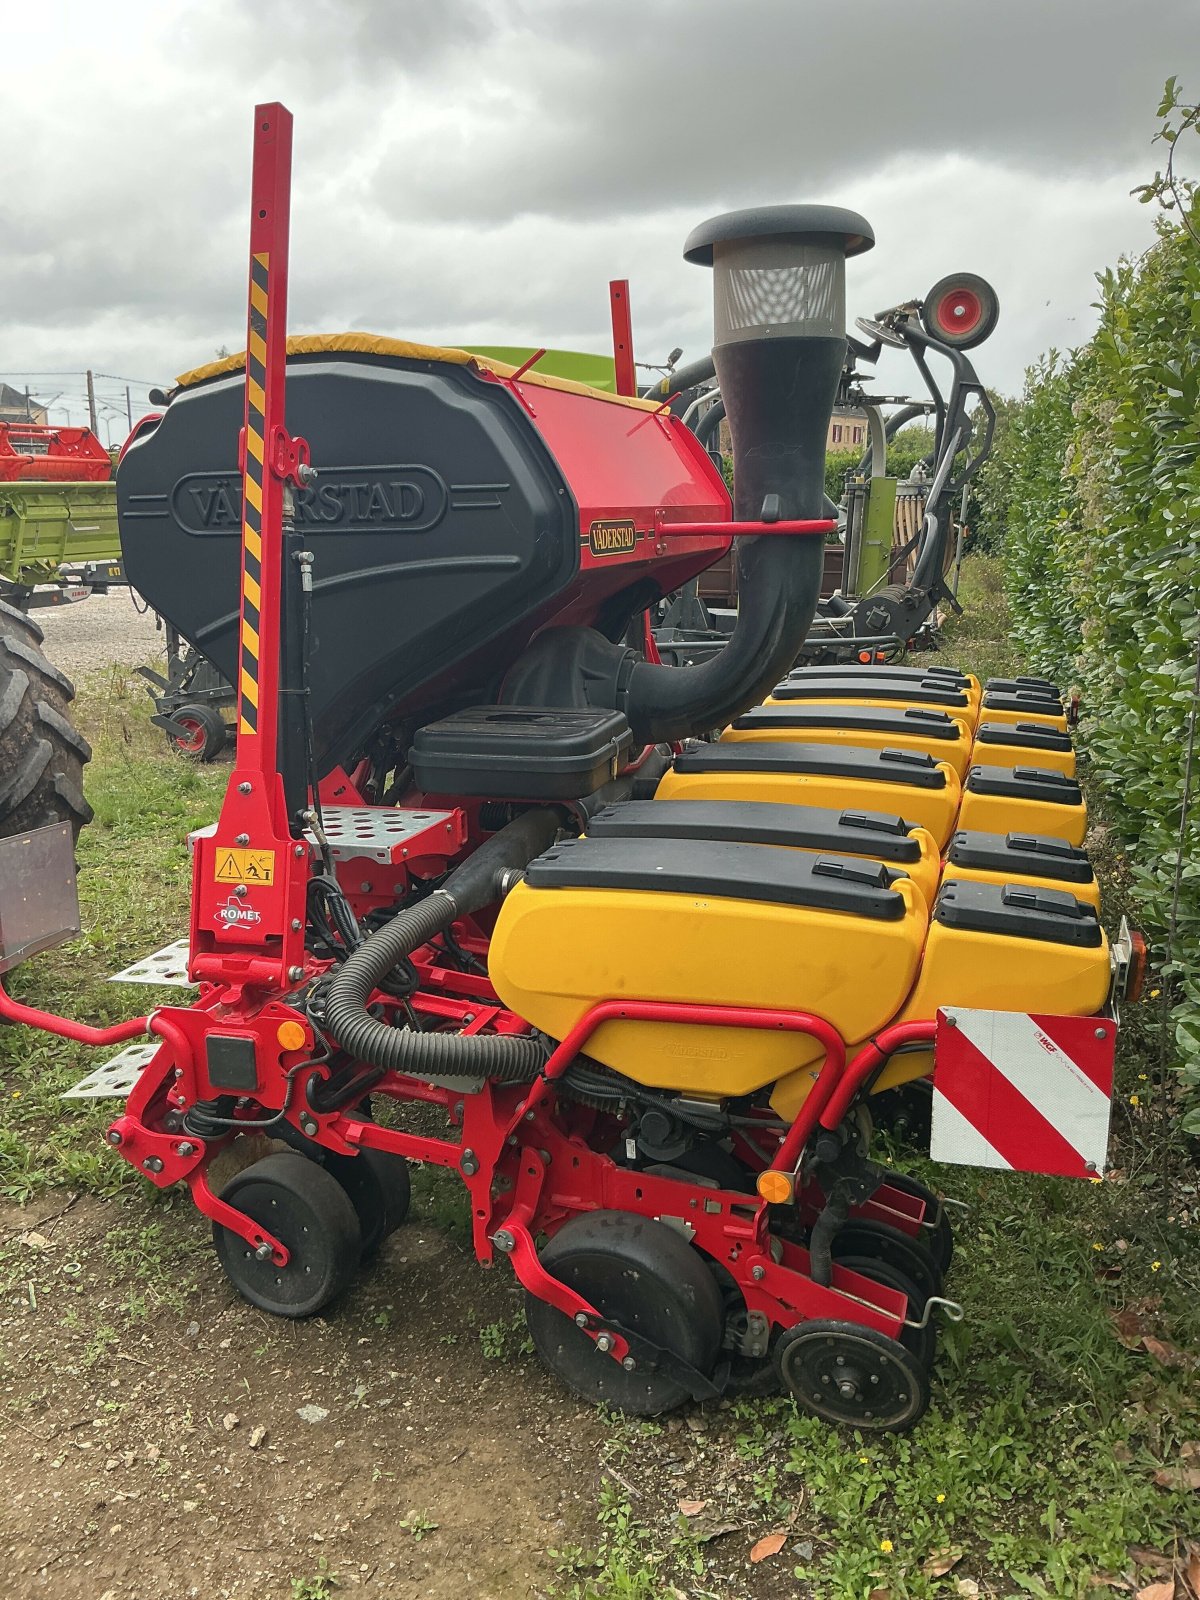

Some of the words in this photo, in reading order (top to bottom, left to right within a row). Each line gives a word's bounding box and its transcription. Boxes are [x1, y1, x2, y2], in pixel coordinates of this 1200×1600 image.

[188, 479, 425, 526] VÄRSTAD
[592, 523, 634, 549] VÄDERSTAD
[220, 909, 261, 920] ROMET
[1039, 1036, 1058, 1053] WGF
